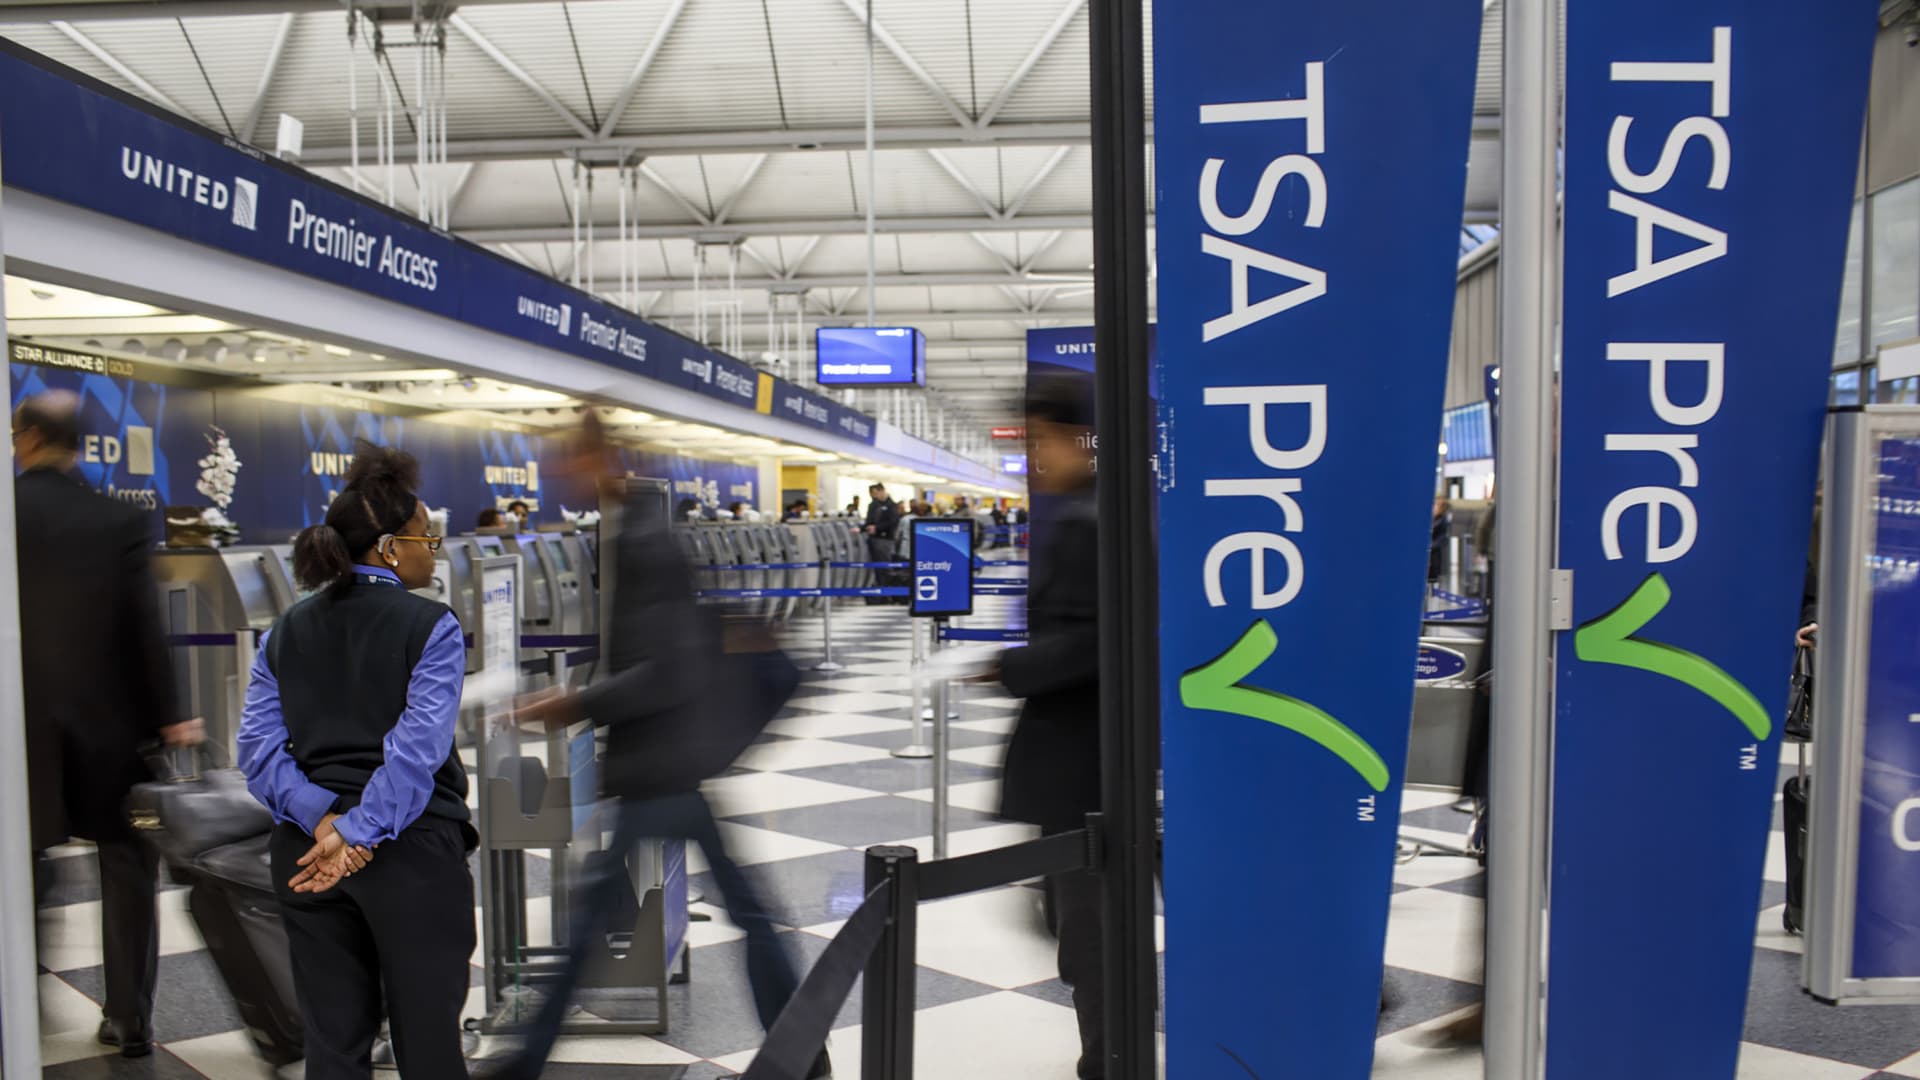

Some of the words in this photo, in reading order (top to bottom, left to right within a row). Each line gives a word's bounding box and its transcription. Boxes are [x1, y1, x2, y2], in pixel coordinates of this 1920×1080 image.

[122, 146, 228, 210] UNITED
[1608, 26, 1732, 298] TSA
[1199, 61, 1328, 343] TSA
[287, 199, 377, 269] Premier
[378, 235, 438, 291] Access
[518, 296, 560, 326] UNITED
[580, 311, 618, 351] Premier
[618, 327, 647, 361] Access
[1055, 343, 1096, 355] UNIT
[15, 345, 43, 362] STAR
[44, 350, 94, 370] ALLIANCE
[108, 359, 134, 377] GOLD
[1601, 342, 1726, 563] Pre
[485, 466, 526, 485] UNITED
[1203, 384, 1328, 609] Pre
[917, 560, 933, 571] Exit
[934, 560, 952, 572] only
[1740, 744, 1758, 770] TM
[1357, 795, 1375, 821] TM
